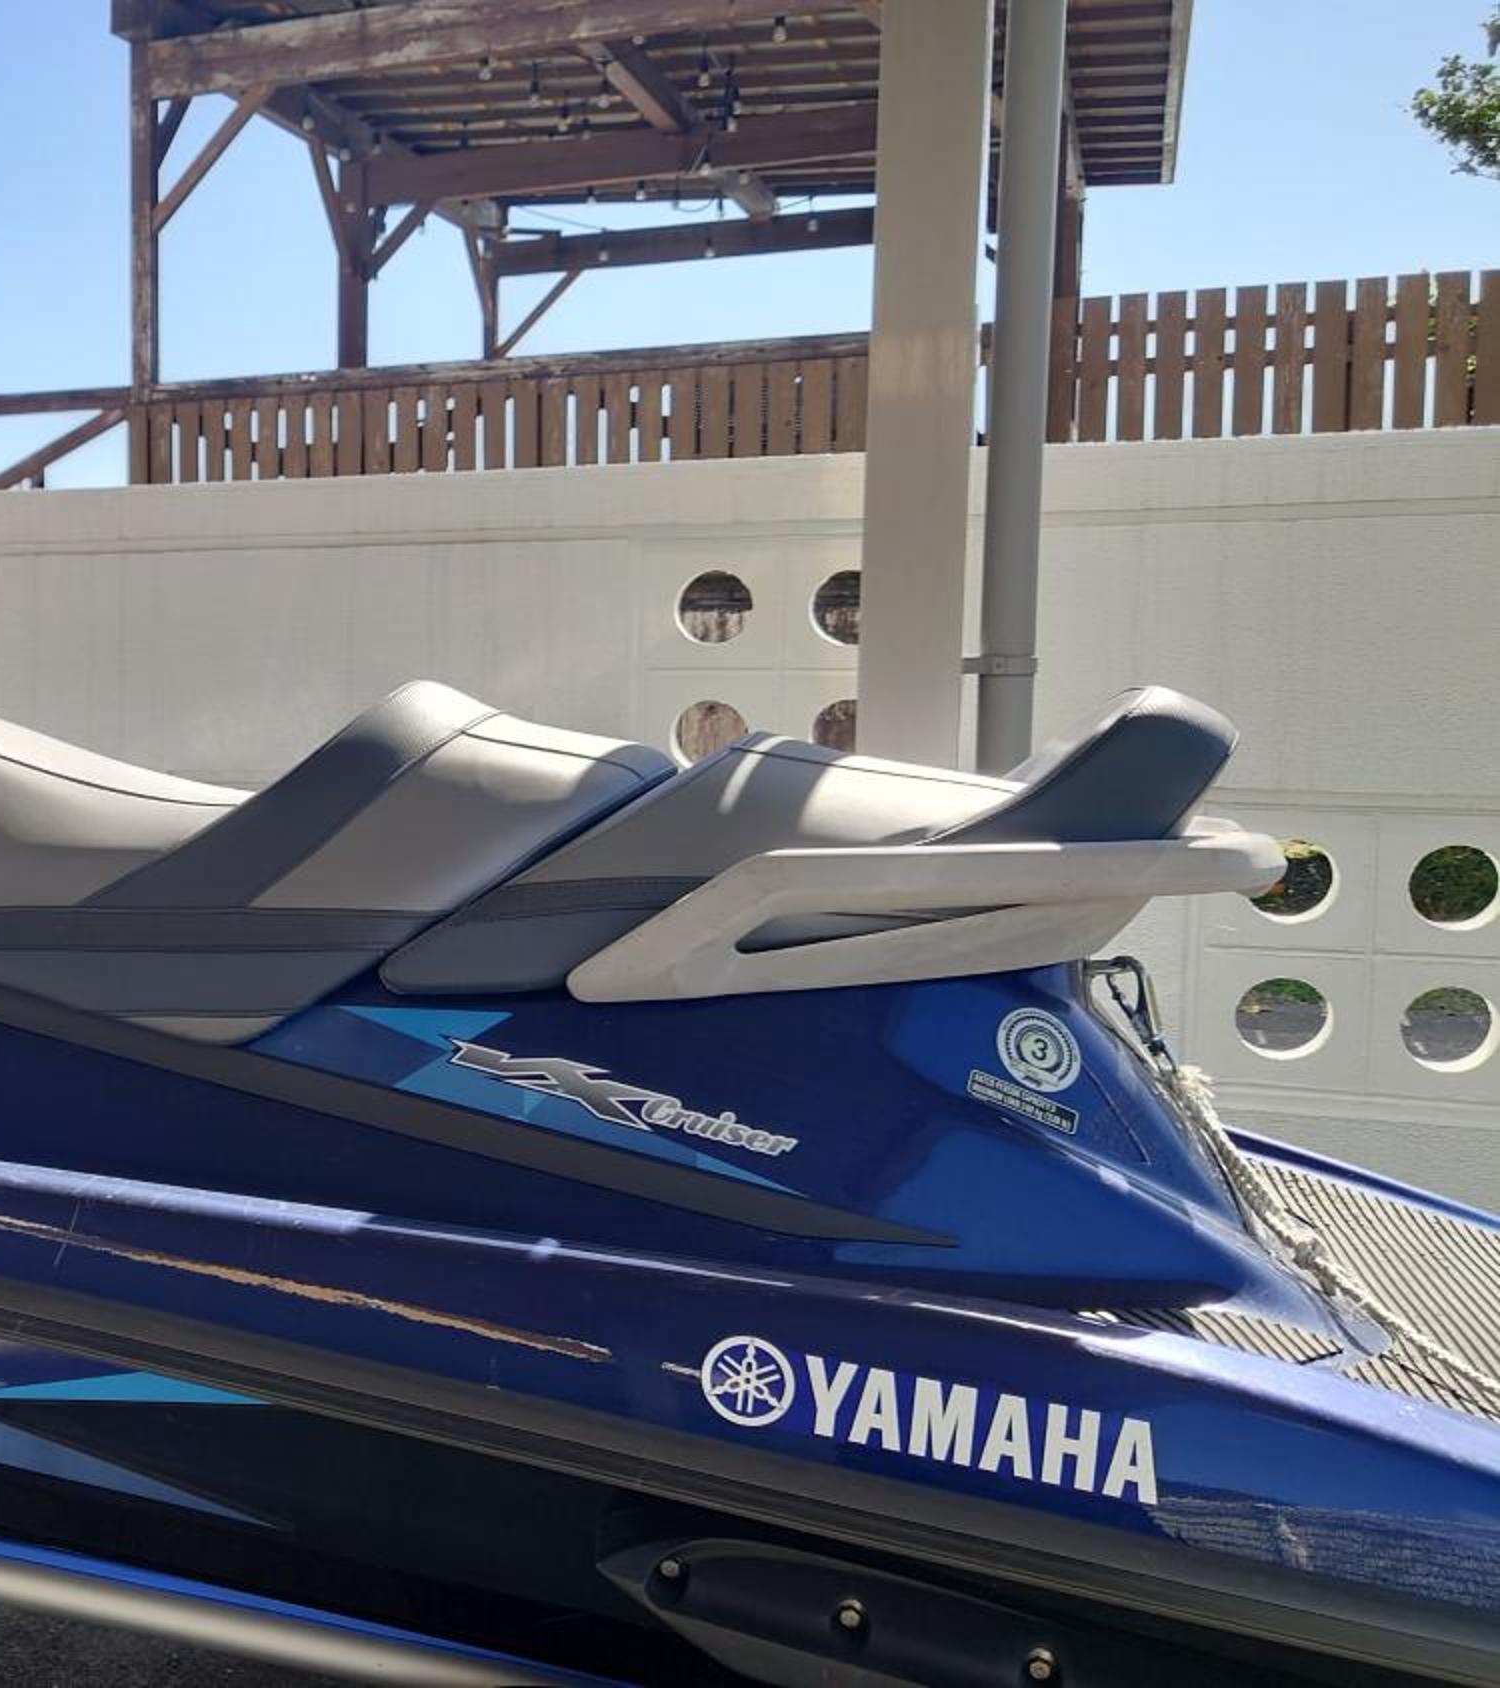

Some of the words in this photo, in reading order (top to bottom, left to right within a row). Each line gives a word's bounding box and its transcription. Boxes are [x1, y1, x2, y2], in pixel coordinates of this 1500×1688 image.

[1031, 1038, 1048, 1061] 3
[640, 1096, 799, 1157] Cruiser
[806, 1355, 1159, 1505] YAMAHA
